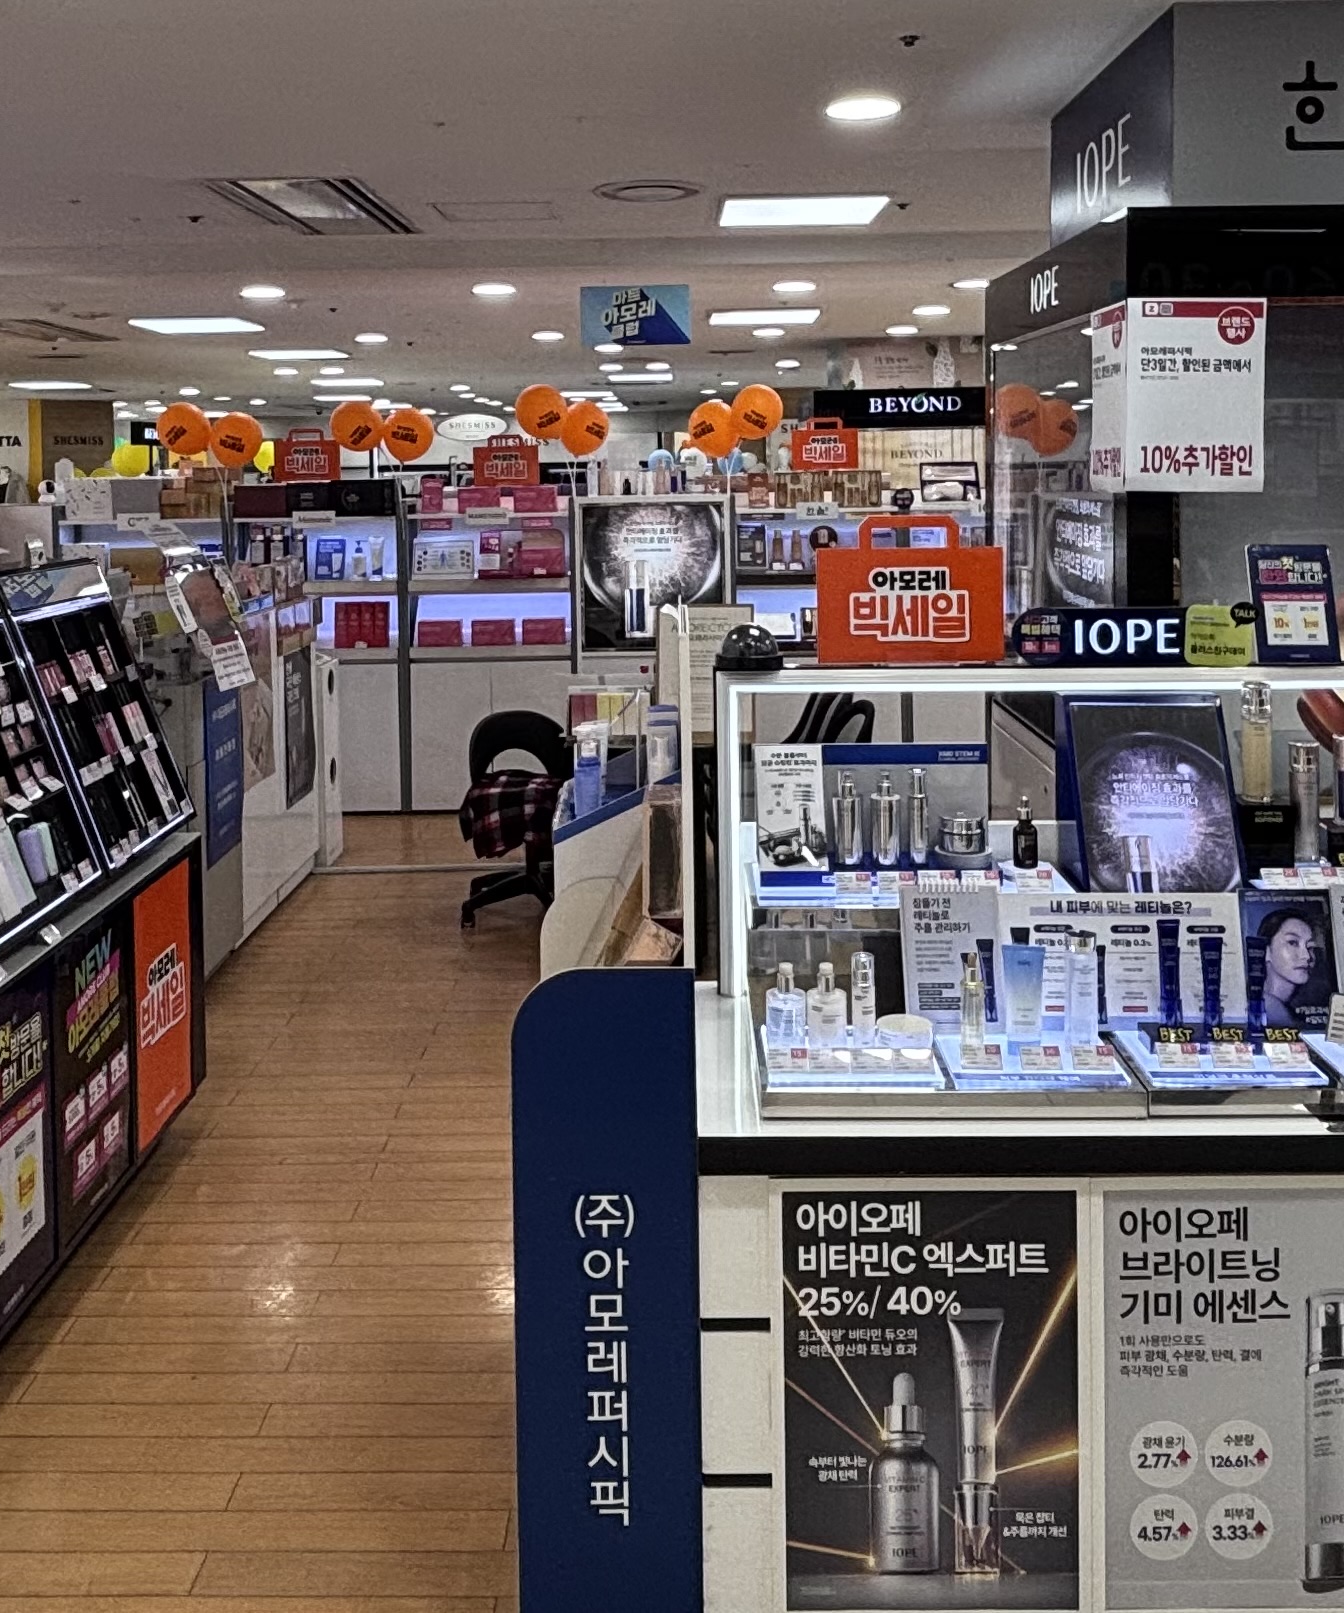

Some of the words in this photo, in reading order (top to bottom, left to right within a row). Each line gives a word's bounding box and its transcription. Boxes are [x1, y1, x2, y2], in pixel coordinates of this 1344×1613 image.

[1076, 112, 1131, 215] IOPE
[1030, 264, 1060, 315] IOPE
[601, 298, 656, 327] 아모레
[1220, 316, 1252, 328] 브랜드
[1226, 327, 1246, 340] 행사
[1140, 346, 1193, 356] 아모레퍼시픽
[1181, 357, 1211, 372] 할인된
[1213, 357, 1252, 373] 금액에서
[869, 393, 962, 414] BEYOND
[53, 435, 104, 446] SHESMISS
[803, 445, 846, 462] 빅세일
[890, 448, 943, 460] BEYOND
[1139, 444, 1253, 476] 10%추가할인
[286, 457, 329, 473] 빅세일
[485, 462, 527, 478] 빅세일
[872, 568, 949, 591] 아모레
[849, 593, 969, 641] 빅세일
[1074, 617, 1180, 655] IOPE
[1050, 900, 1063, 914] 내
[1065, 900, 1103, 914] 피부에
[1134, 900, 1193, 915] 레티놀은?
[934, 922, 971, 934] 관리하기
[74, 935, 111, 997] NEW
[148, 946, 177, 987] 아모레
[141, 964, 186, 1048] 빅세일
[1159, 1027, 1193, 1042] BEST
[1212, 1026, 1245, 1041] BEST
[1265, 1027, 1300, 1041] BEST
[795, 1200, 922, 1238] 아이오페
[1118, 1206, 1249, 1243] 아이오페
[797, 1241, 917, 1279] 비타민C
[922, 1240, 1050, 1278] 엑스퍼트
[1119, 1247, 1281, 1284] 브라이트닝
[887, 1285, 962, 1317] 40%
[1119, 1289, 1182, 1325] 기미
[1192, 1288, 1291, 1324] 에센스
[849, 1328, 882, 1342] 비타민
[884, 1328, 918, 1342] 듀오의
[1139, 1334, 1205, 1347] 사용만으로도
[835, 1344, 868, 1357] 항산화
[895, 1343, 918, 1357] 효과
[1119, 1349, 1141, 1362] 피부
[574, 1193, 636, 1527] (주)아모레퍼시픽
[1166, 1365, 1189, 1378] 도움
[1165, 1436, 1186, 1450] 윤기
[1222, 1434, 1255, 1447] 수분량
[1153, 1508, 1175, 1522] 탄력
[1223, 1508, 1255, 1521] 피부결
[1320, 1514, 1344, 1525] IOPE
